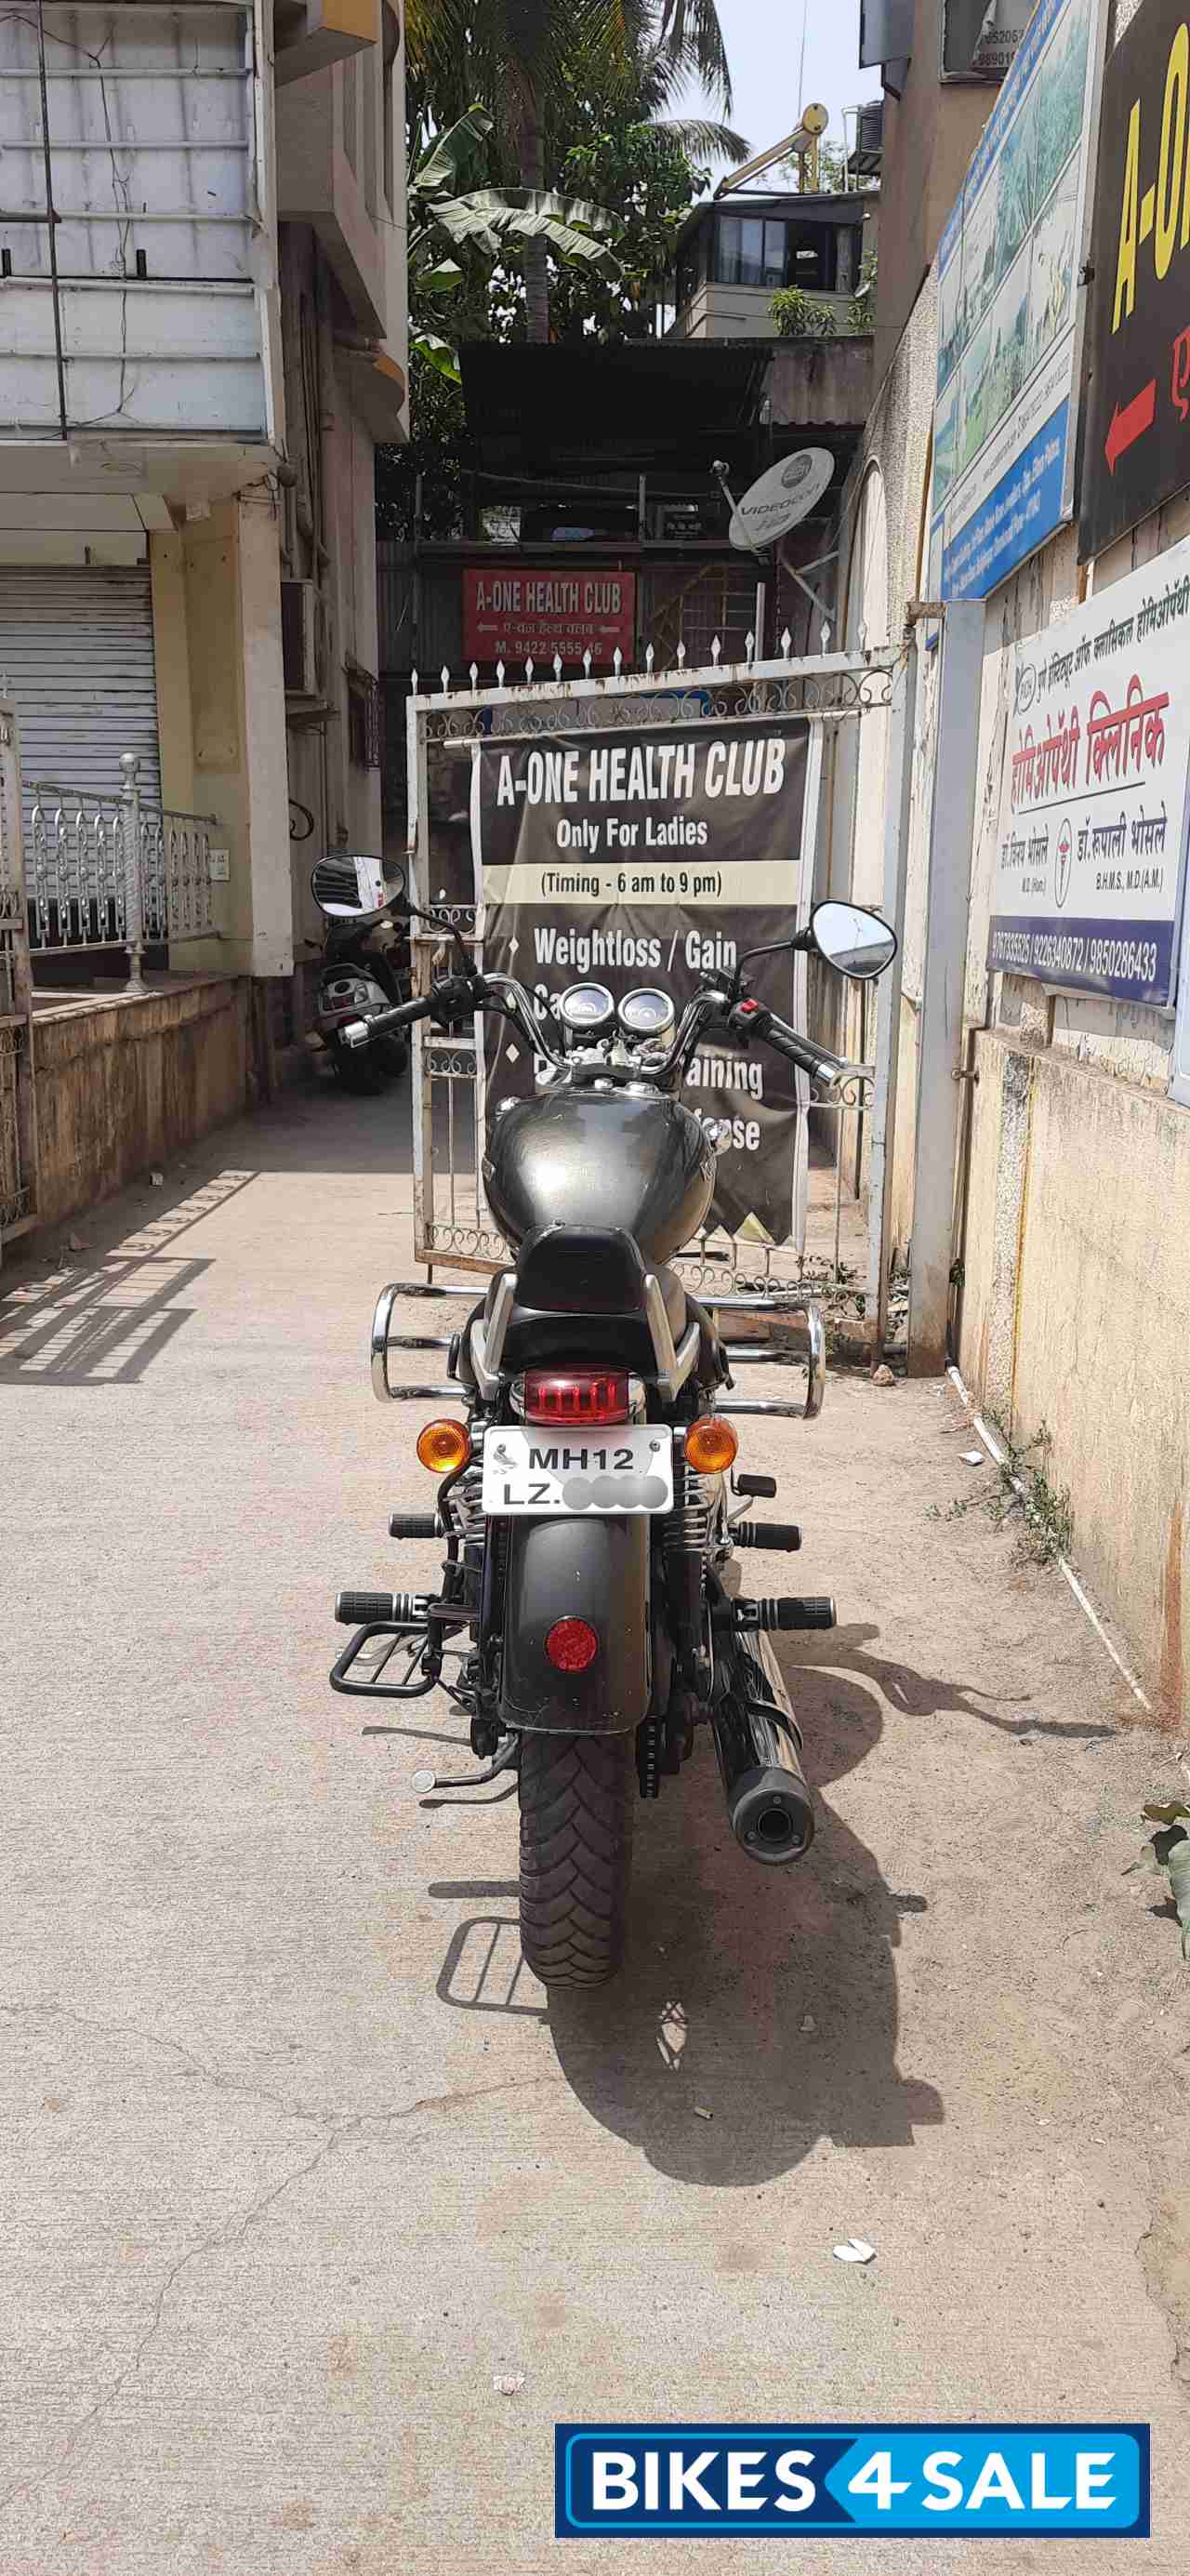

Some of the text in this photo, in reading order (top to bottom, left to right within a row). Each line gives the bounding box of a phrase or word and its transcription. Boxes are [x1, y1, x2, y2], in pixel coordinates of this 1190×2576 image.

[1112, 23, 1190, 335] A-O
[476, 580, 621, 614] A-ONE HEALTH CLUB
[496, 641, 510, 654] M.
[515, 641, 547, 655] 9422
[550, 642, 582, 655] 5555
[496, 737, 785, 806] A-ONE HEALTH CLUB
[557, 817, 707, 853] Only For Ladies
[541, 871, 600, 896] (Timing
[617, 873, 626, 893] 6
[631, 877, 654, 893] am
[661, 873, 675, 893] to
[680, 873, 689, 893] 9
[694, 871, 721, 896] pm)
[534, 929, 737, 973] Weightloss / Gain
[1090, 938, 1157, 981] 9850286433
[685, 1051, 763, 1100] aining
[529, 1448, 634, 1470] MH12
